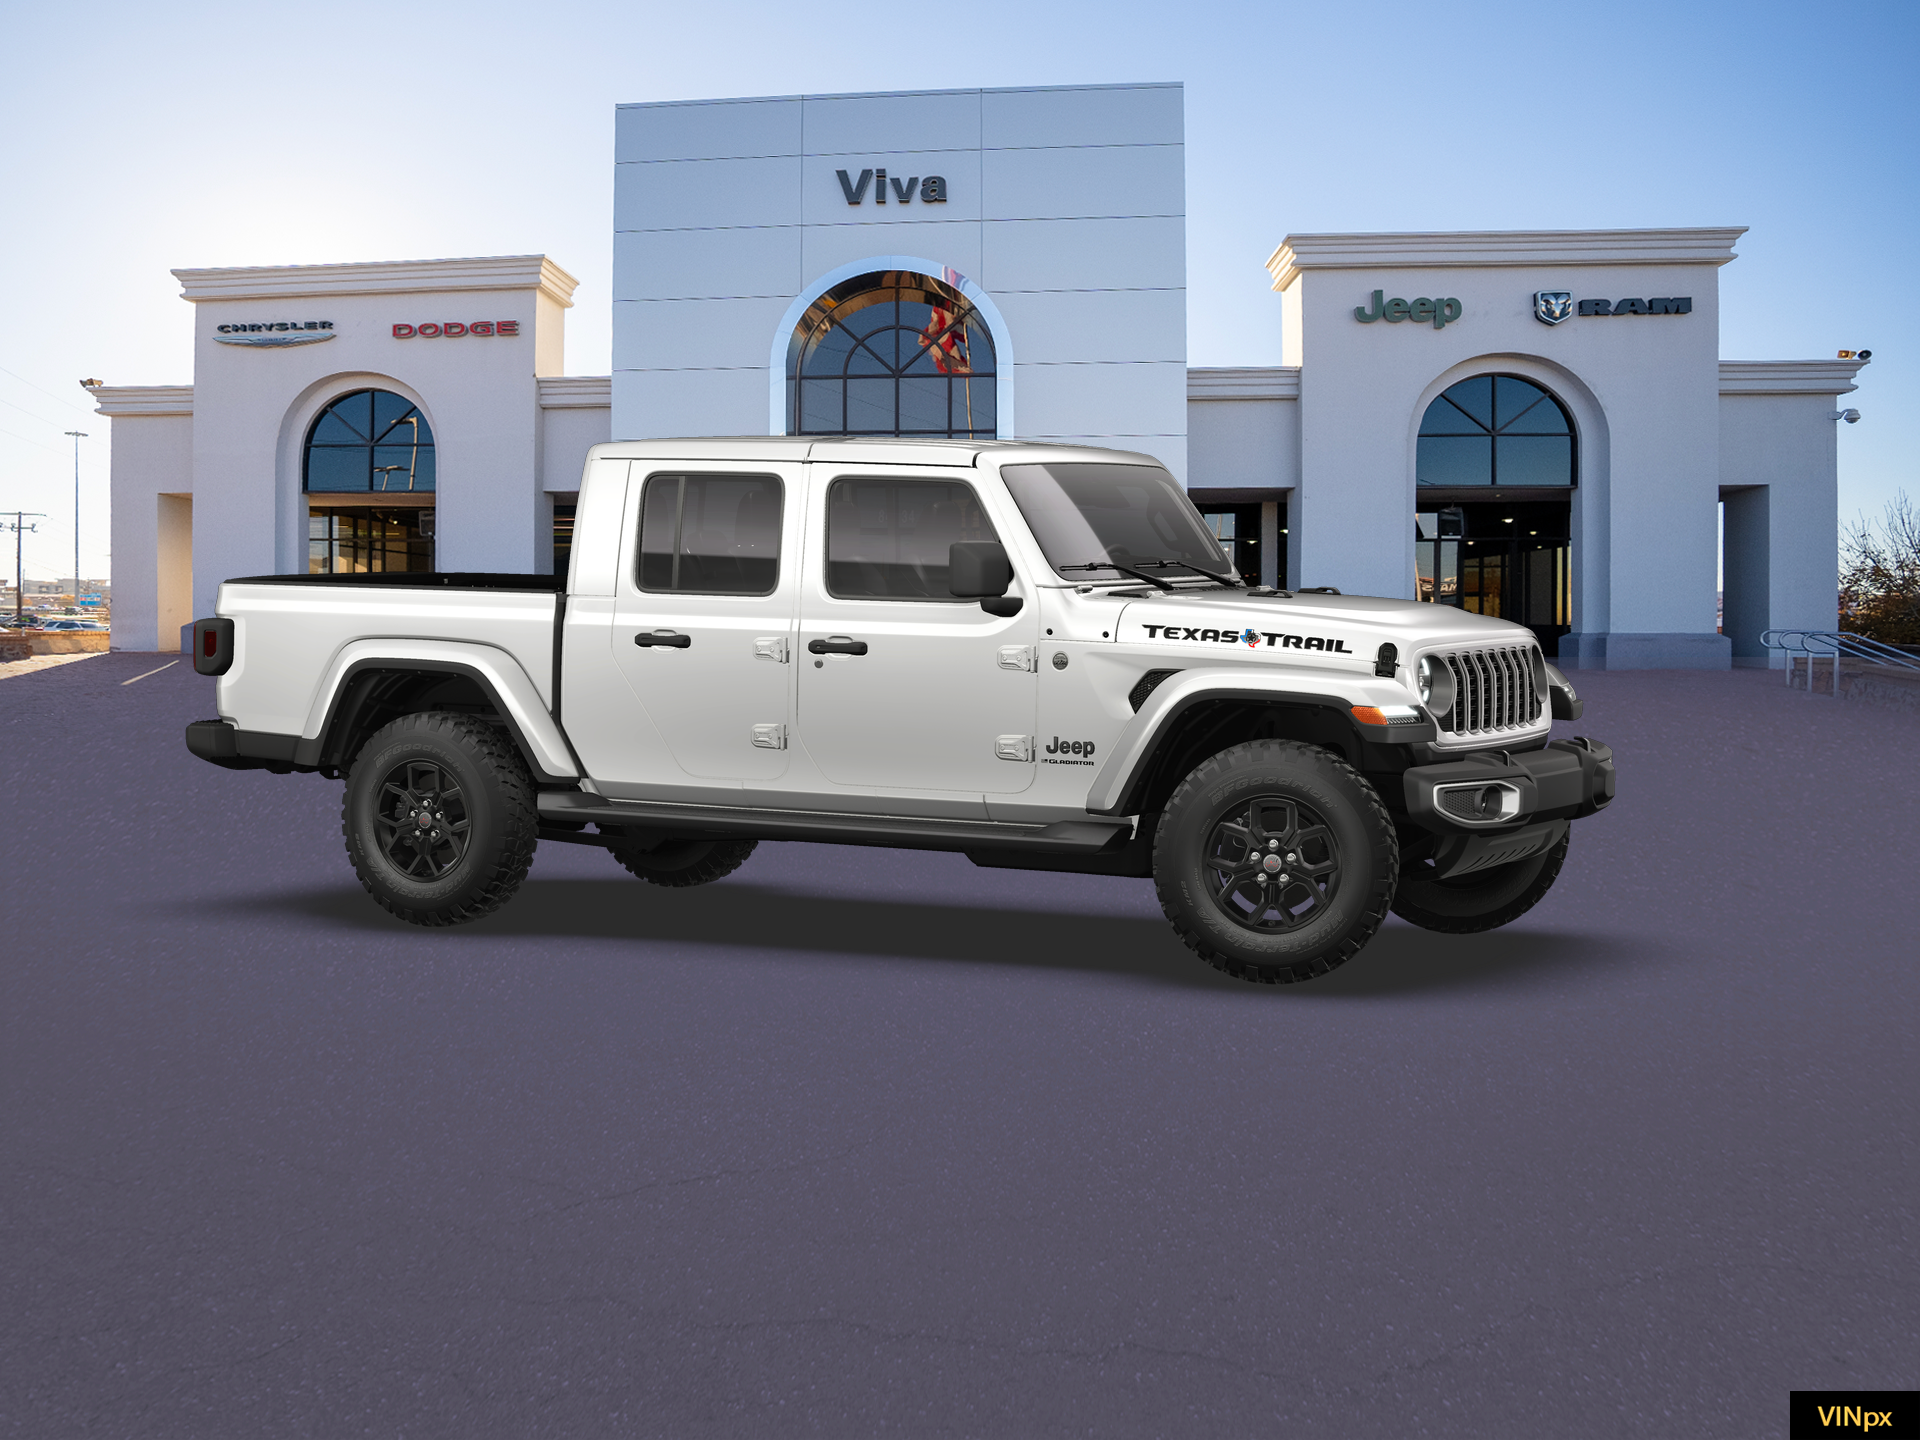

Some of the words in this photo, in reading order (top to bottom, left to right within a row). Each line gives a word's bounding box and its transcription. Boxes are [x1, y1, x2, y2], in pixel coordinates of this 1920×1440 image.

[835, 168, 948, 206] Viva
[1354, 289, 1462, 329] Jeep
[1578, 297, 1692, 317] RAM
[217, 320, 334, 333] CHRYSLER
[392, 320, 520, 338] DODGE
[1142, 624, 1240, 643] TEXAS
[1260, 632, 1353, 654] TRAIL
[1045, 735, 1095, 758] Jeep
[1049, 758, 1095, 766] GLADIATOR
[1211, 775, 1333, 808] BFGoodrich
